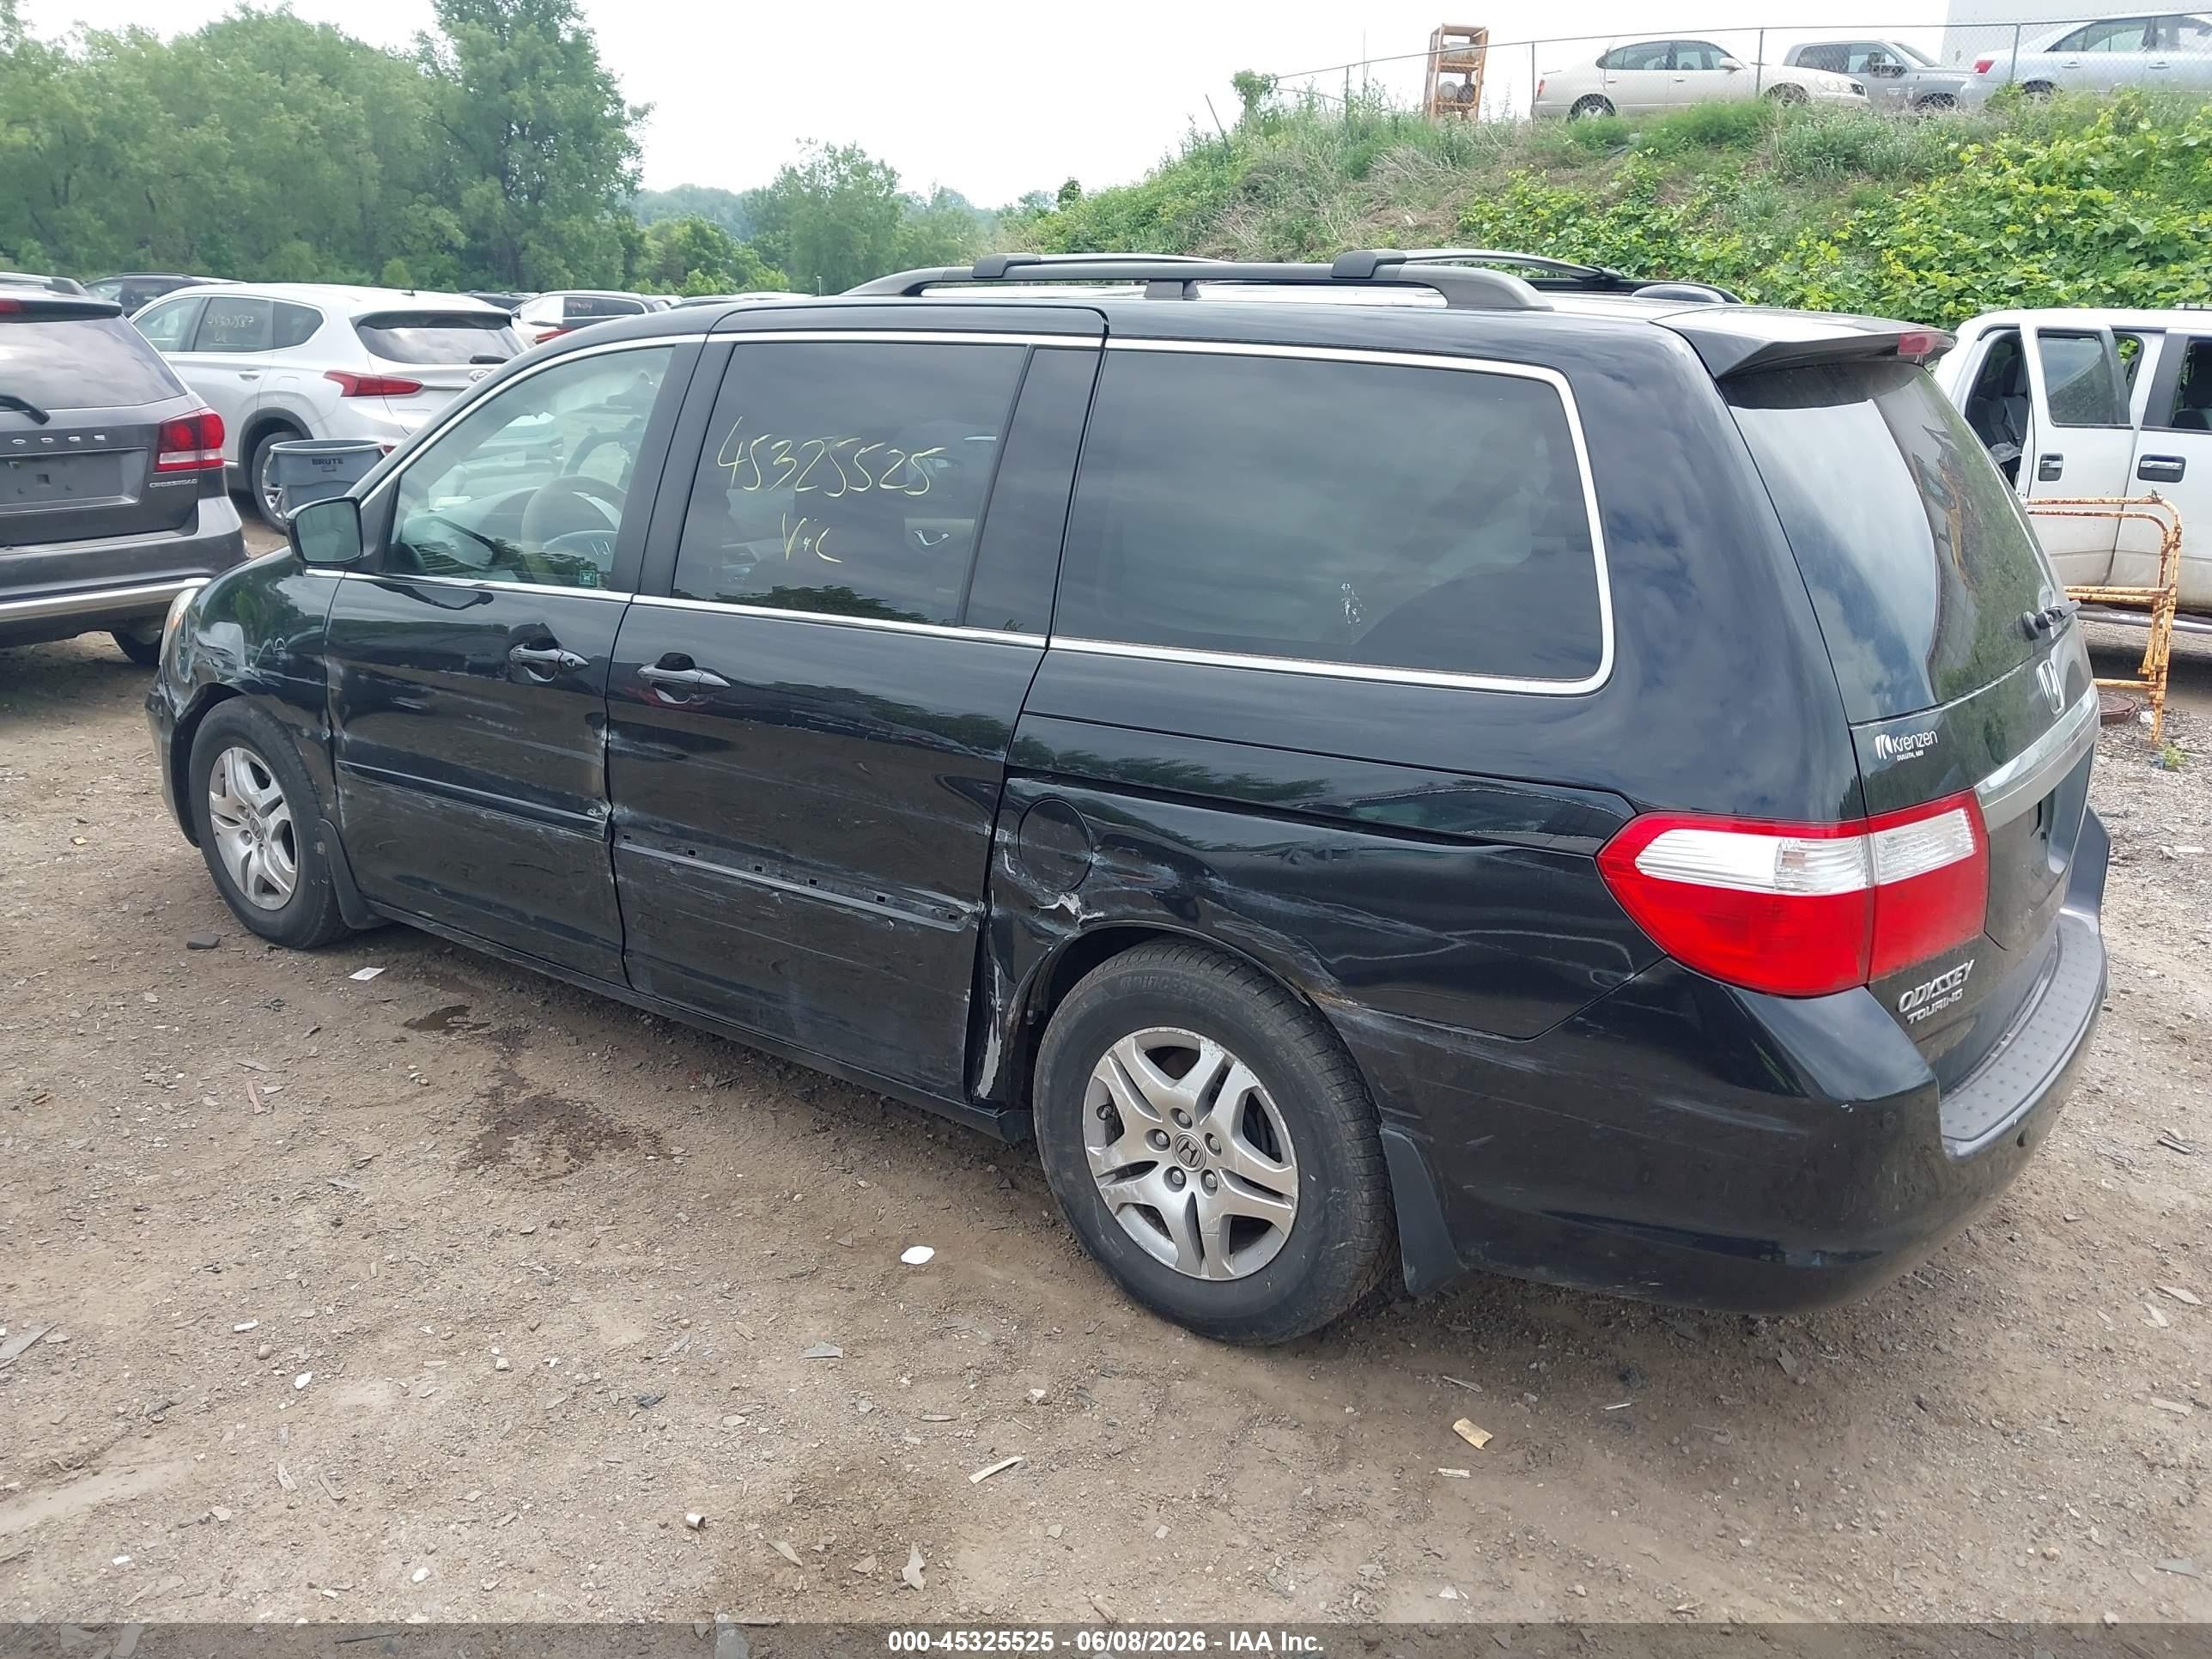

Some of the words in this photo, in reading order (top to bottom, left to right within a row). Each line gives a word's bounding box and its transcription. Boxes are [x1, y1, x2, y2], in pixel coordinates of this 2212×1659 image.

[11, 434, 106, 445] ODGE
[718, 416, 945, 497] 45325525
[1892, 730, 1938, 753] Krenzen
[1898, 958, 1975, 1013] ODYSSEY
[1906, 988, 1963, 1024] TOURING
